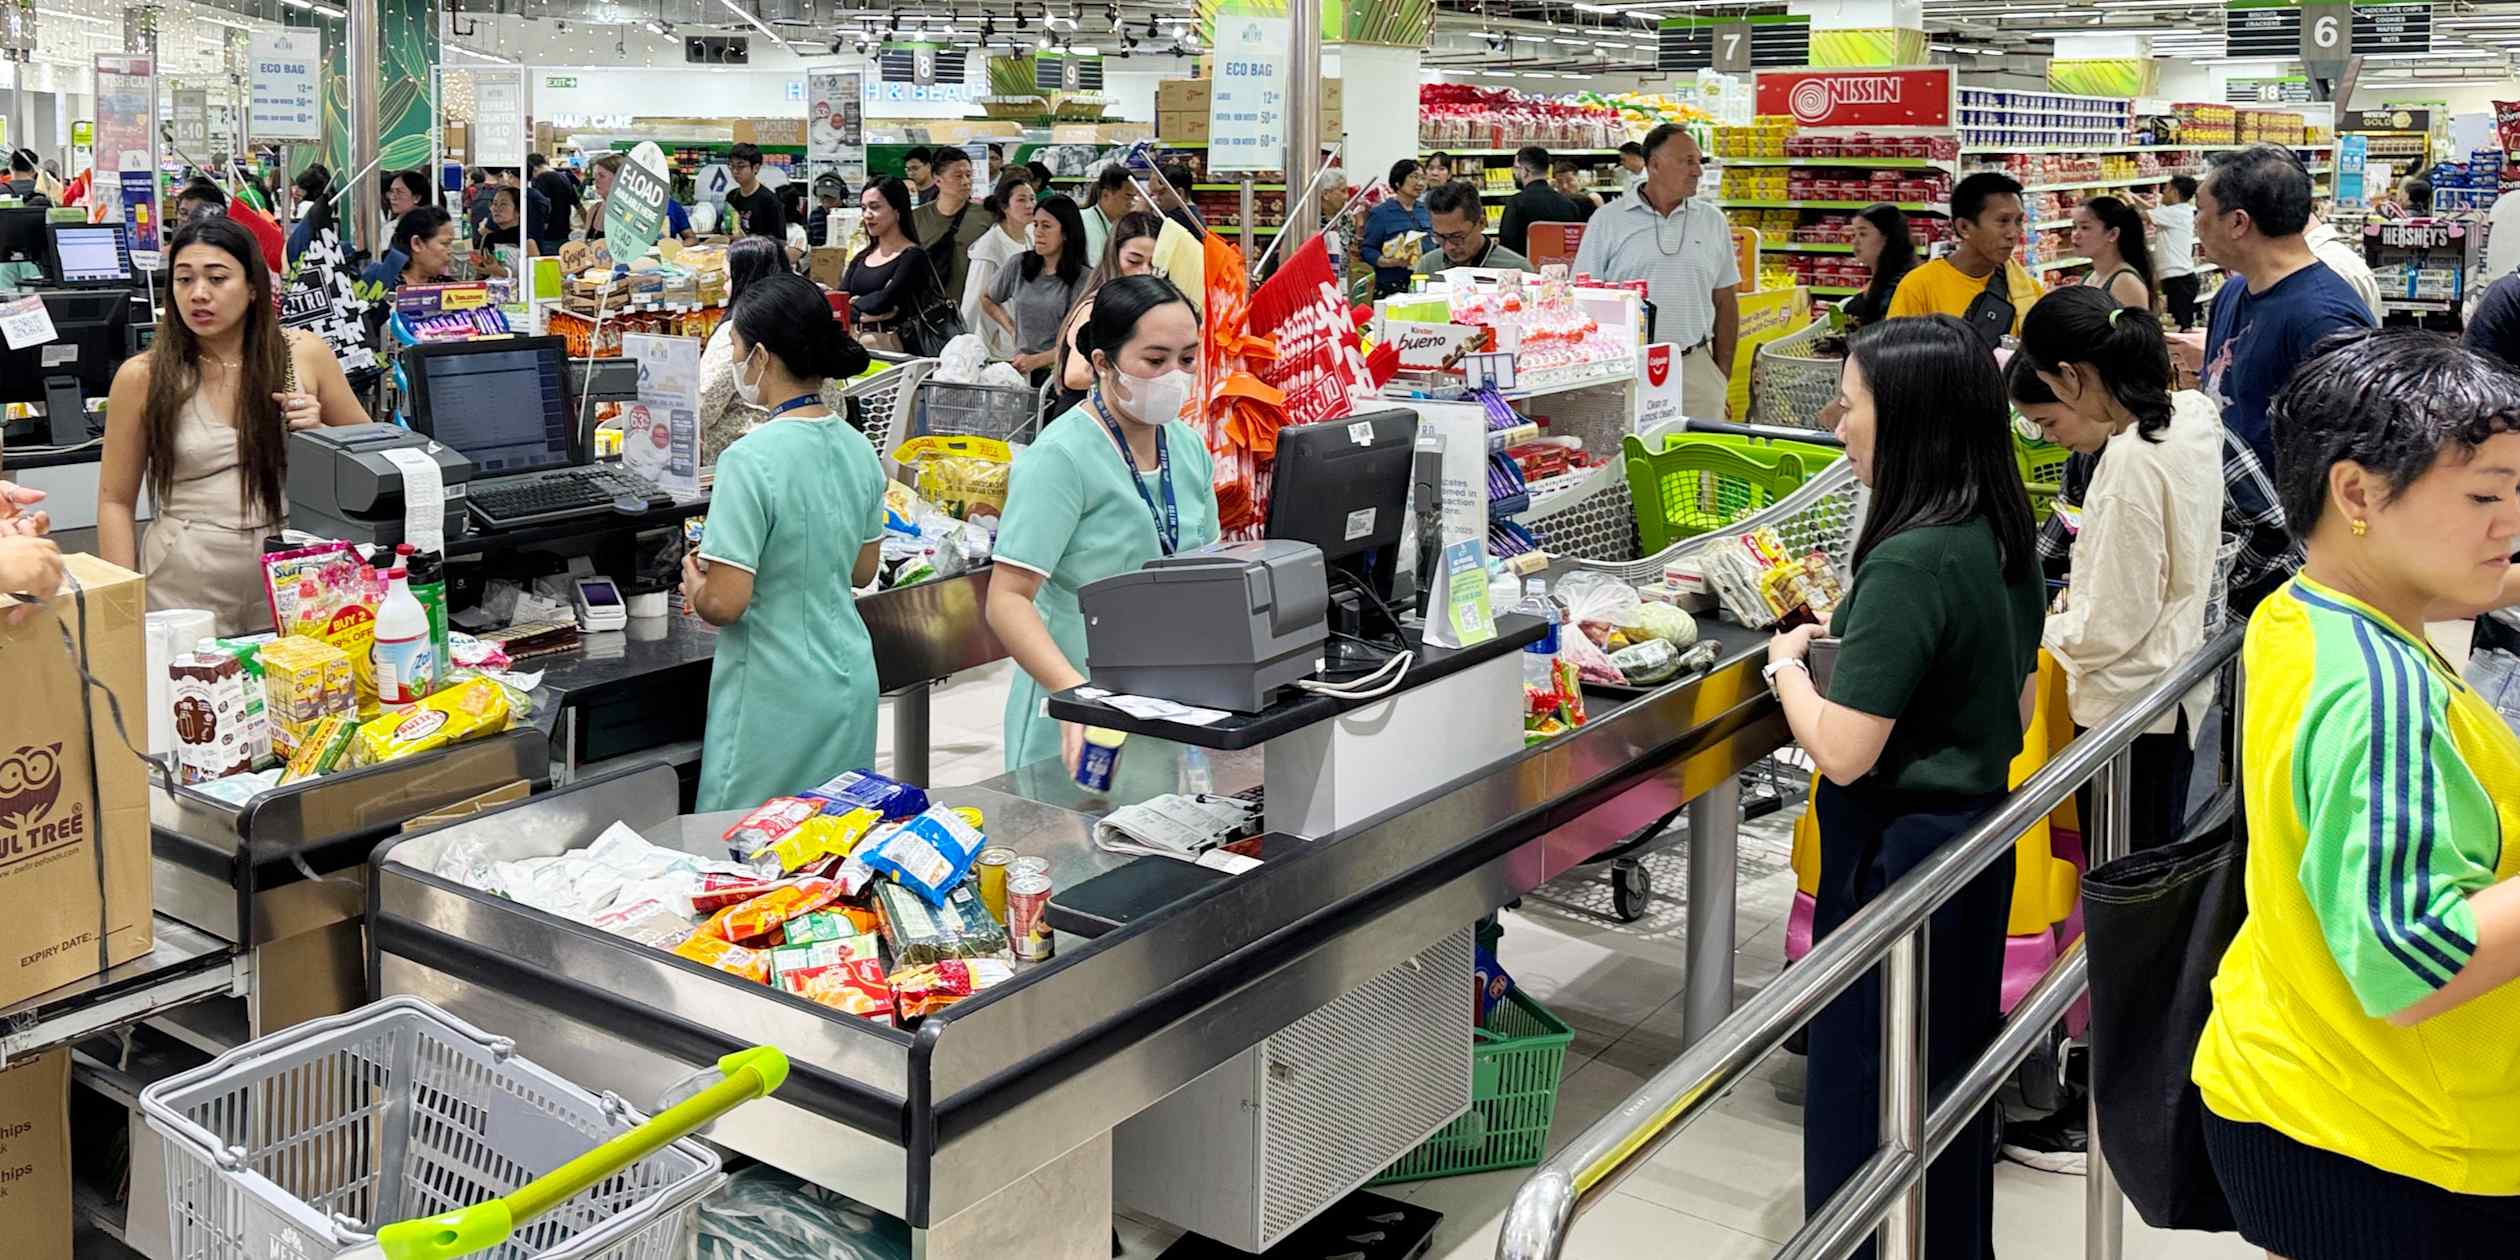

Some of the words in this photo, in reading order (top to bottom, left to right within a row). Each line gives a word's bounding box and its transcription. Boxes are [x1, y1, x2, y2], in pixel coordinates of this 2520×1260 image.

[2313, 16, 2338, 48] 6
[1722, 33, 1741, 61] 7
[261, 64, 281, 73] ECO
[284, 64, 305, 74] BAG
[919, 56, 931, 78] 8
[1065, 65, 1077, 85] 9
[1226, 62, 1248, 76] ECO
[1251, 63, 1273, 76] BAG
[1824, 77, 1900, 104] NISSIN
[2258, 86, 2279, 100] 18
[592, 114, 633, 128] CARE
[2363, 118, 2392, 127] GOLD
[620, 163, 664, 208] E-LOAD
[2382, 226, 2448, 248] HERSHEY'S
[1399, 332, 1447, 350] bueno
[332, 614, 357, 632] BUY
[358, 611, 367, 622] 2
[26, 813, 83, 849] TREE
[20, 942, 60, 968] EXPIRY
[61, 932, 93, 952] DATE:
